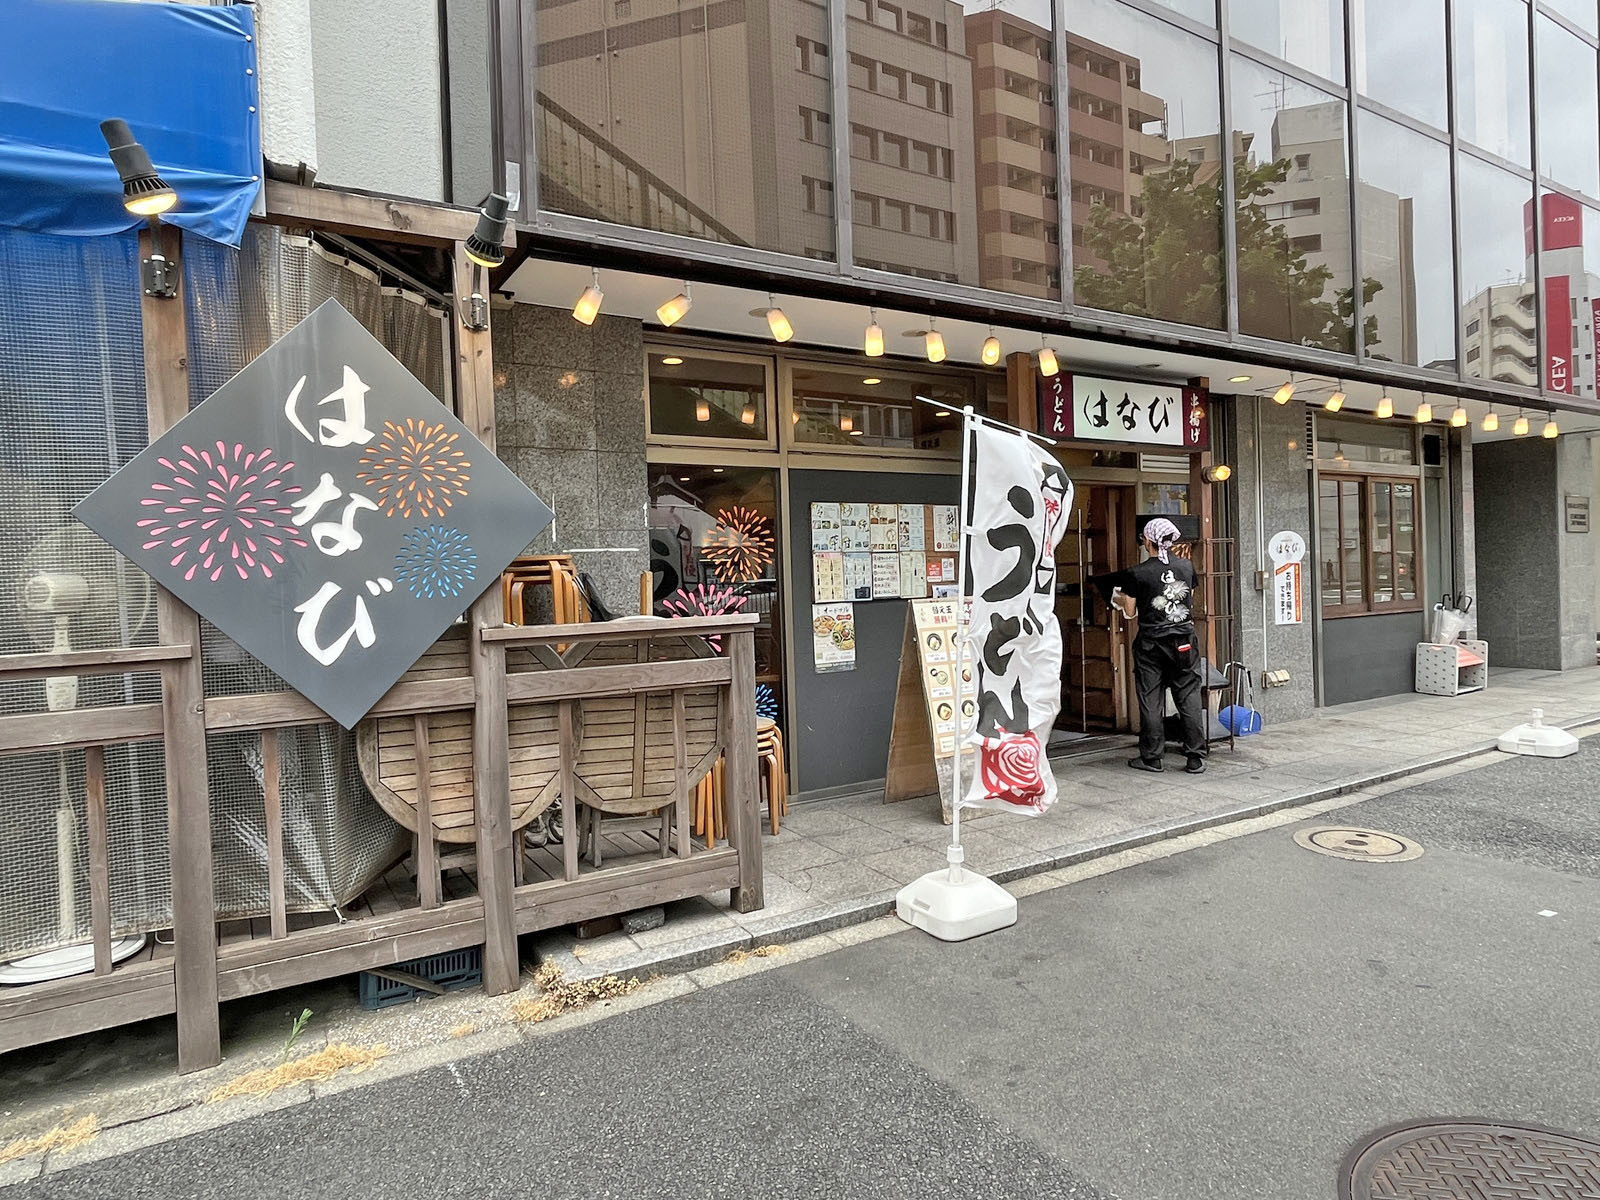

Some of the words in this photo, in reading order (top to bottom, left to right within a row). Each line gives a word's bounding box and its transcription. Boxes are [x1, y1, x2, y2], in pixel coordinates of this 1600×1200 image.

[1052, 377, 1066, 433] うどん
[1083, 389, 1175, 434] はなび
[284, 364, 393, 667] はなび
[1160, 569, 1181, 615] はなび
